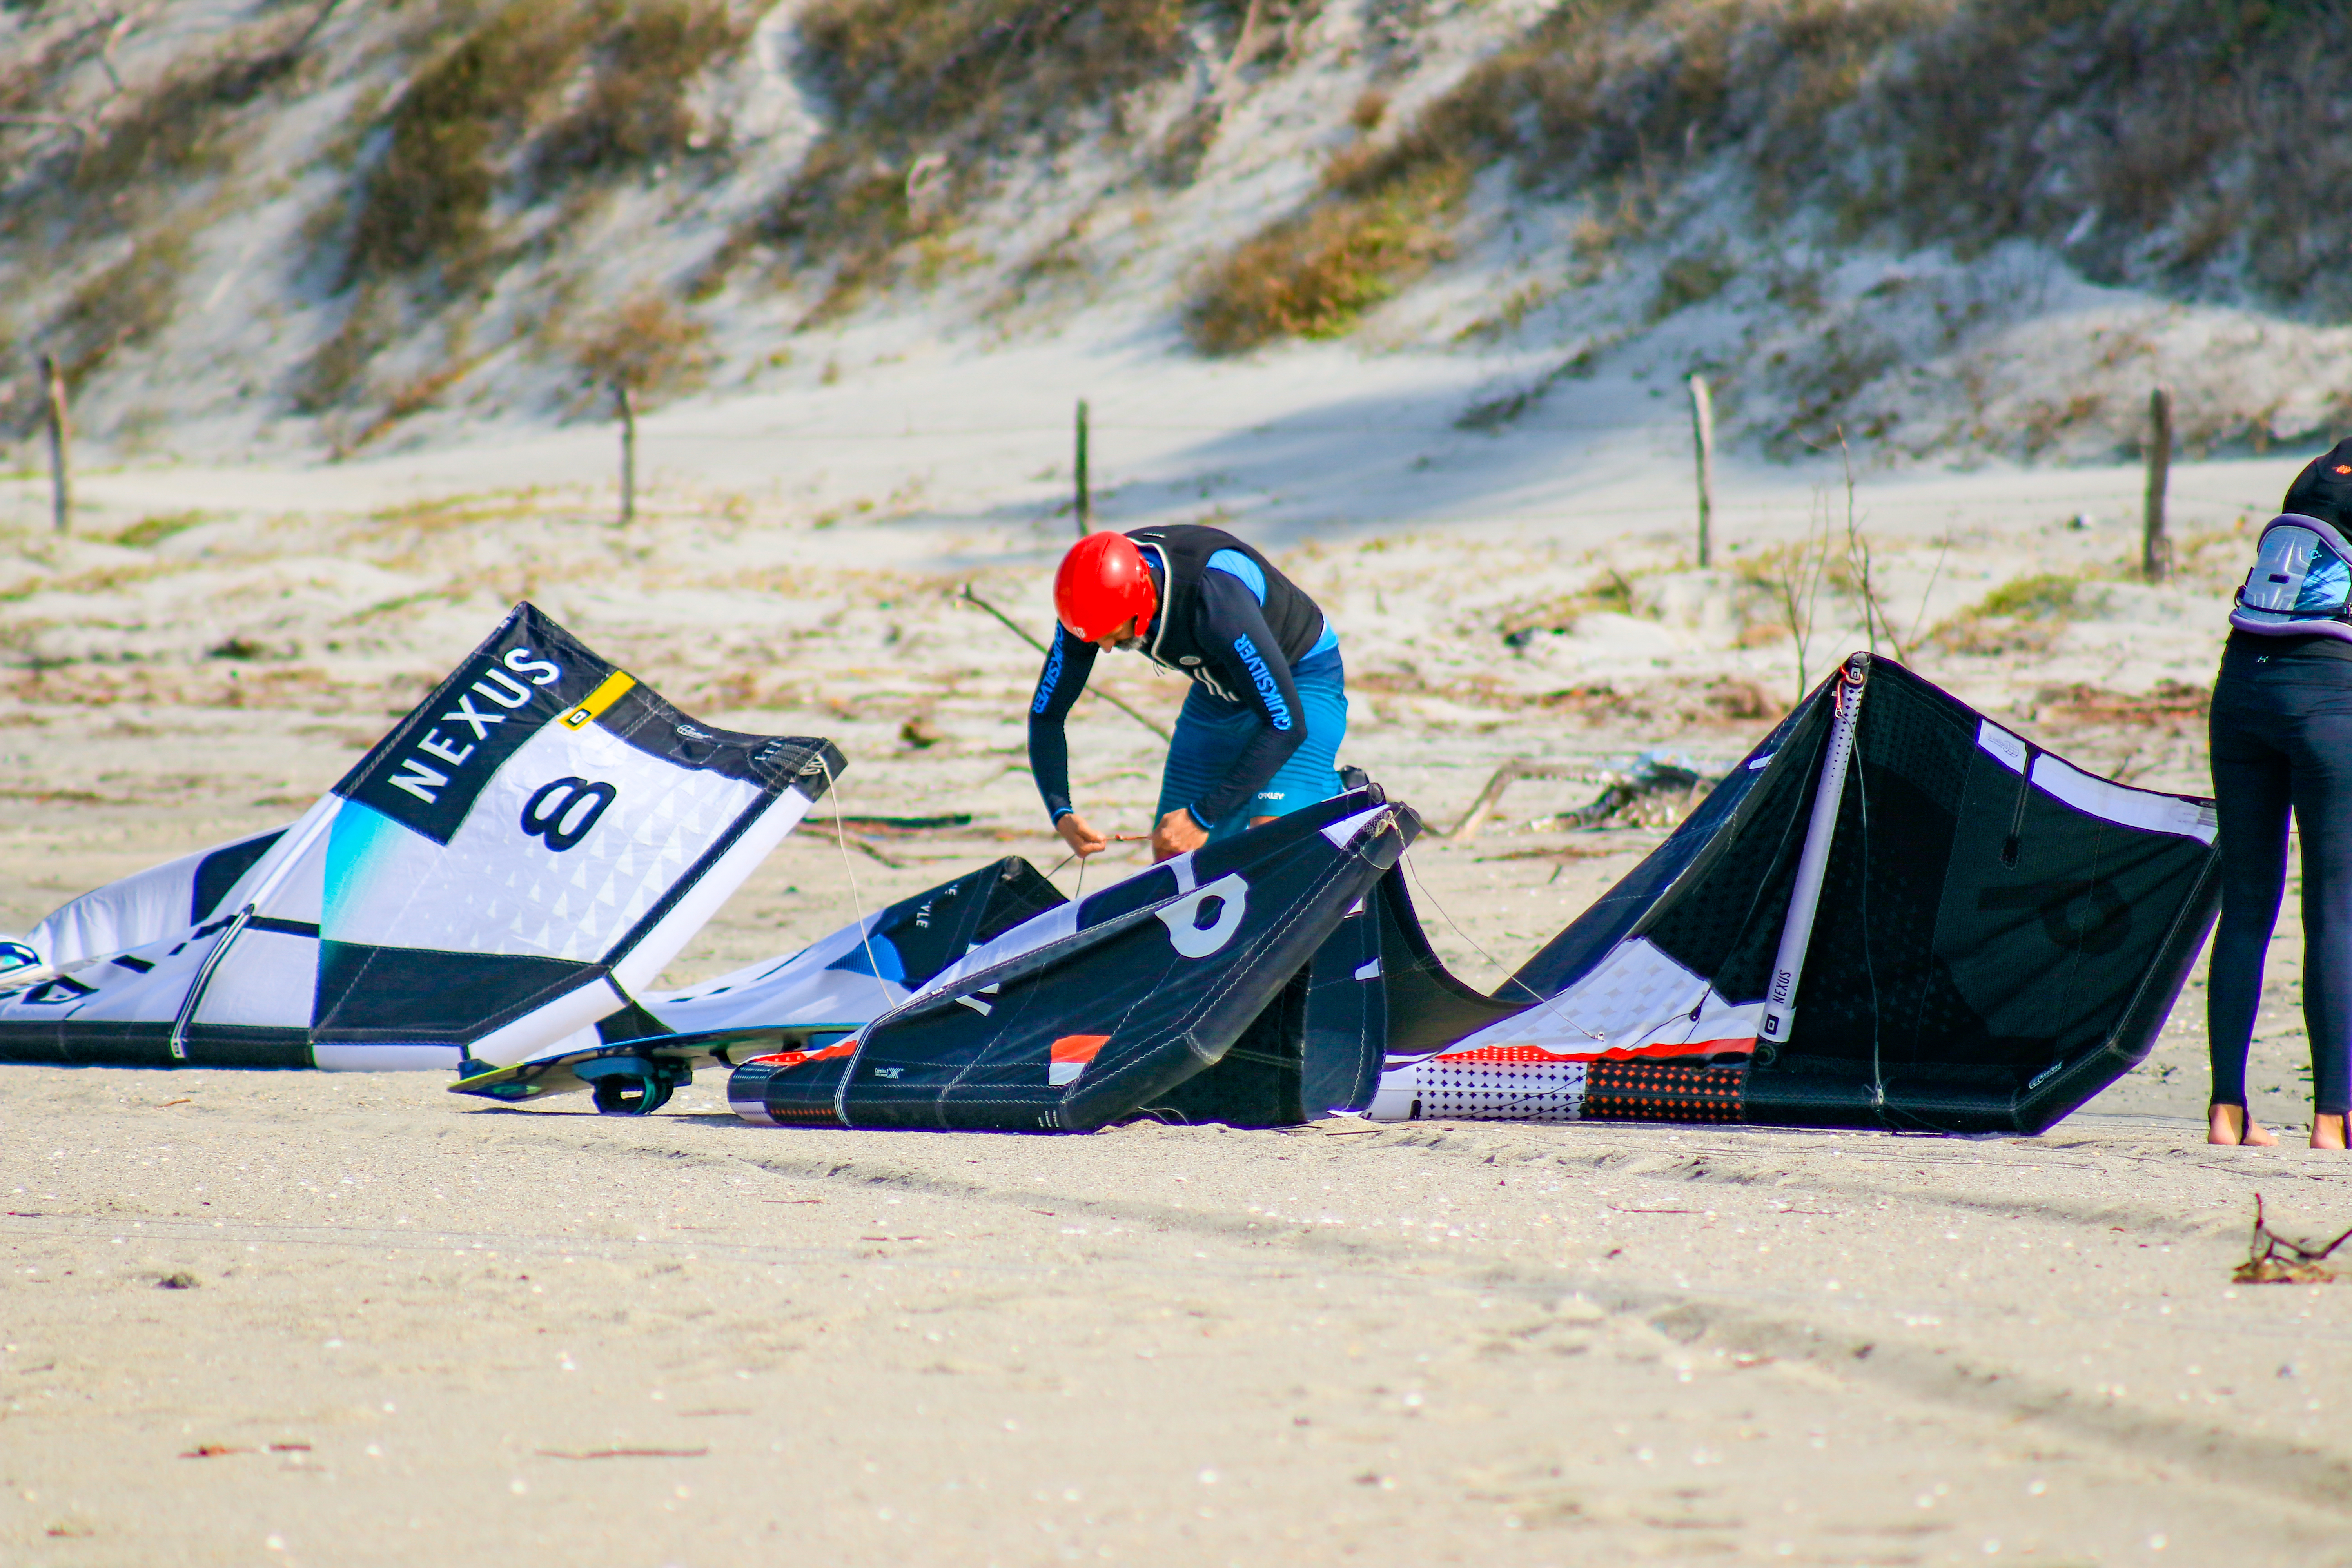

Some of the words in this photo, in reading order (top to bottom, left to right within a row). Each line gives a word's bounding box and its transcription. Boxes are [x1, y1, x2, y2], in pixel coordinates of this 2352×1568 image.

[1234, 633, 1292, 730] QUIKSILVER
[387, 648, 561, 804] NEXUS
[520, 777, 616, 852] 8
[1772, 969, 1791, 1004] NEXUS
